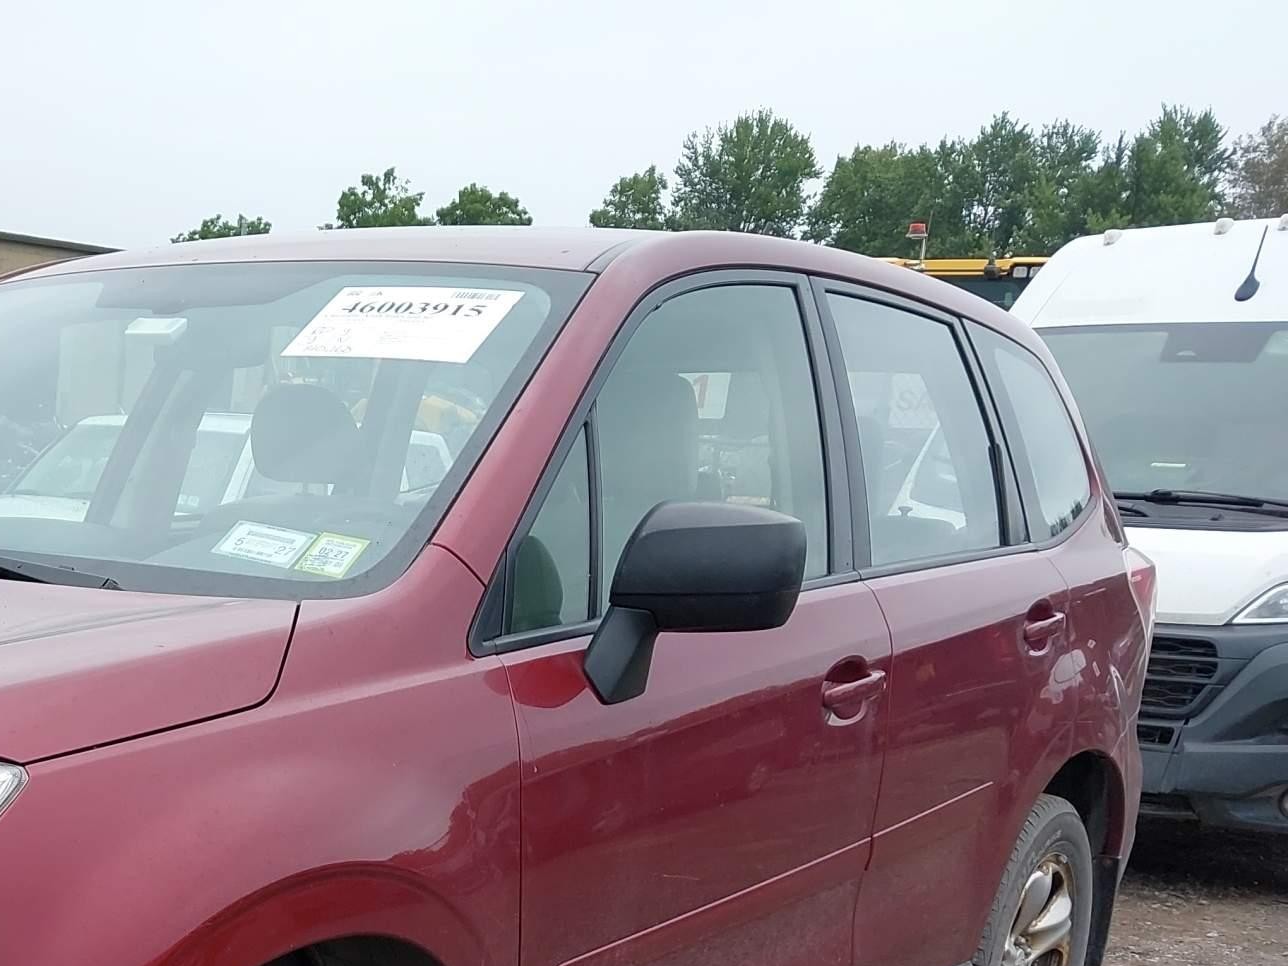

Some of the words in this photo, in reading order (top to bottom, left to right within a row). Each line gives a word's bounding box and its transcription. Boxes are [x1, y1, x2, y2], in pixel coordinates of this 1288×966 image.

[341, 300, 487, 318] 46003915
[233, 536, 249, 547] 5
[333, 550, 350, 559] 27
